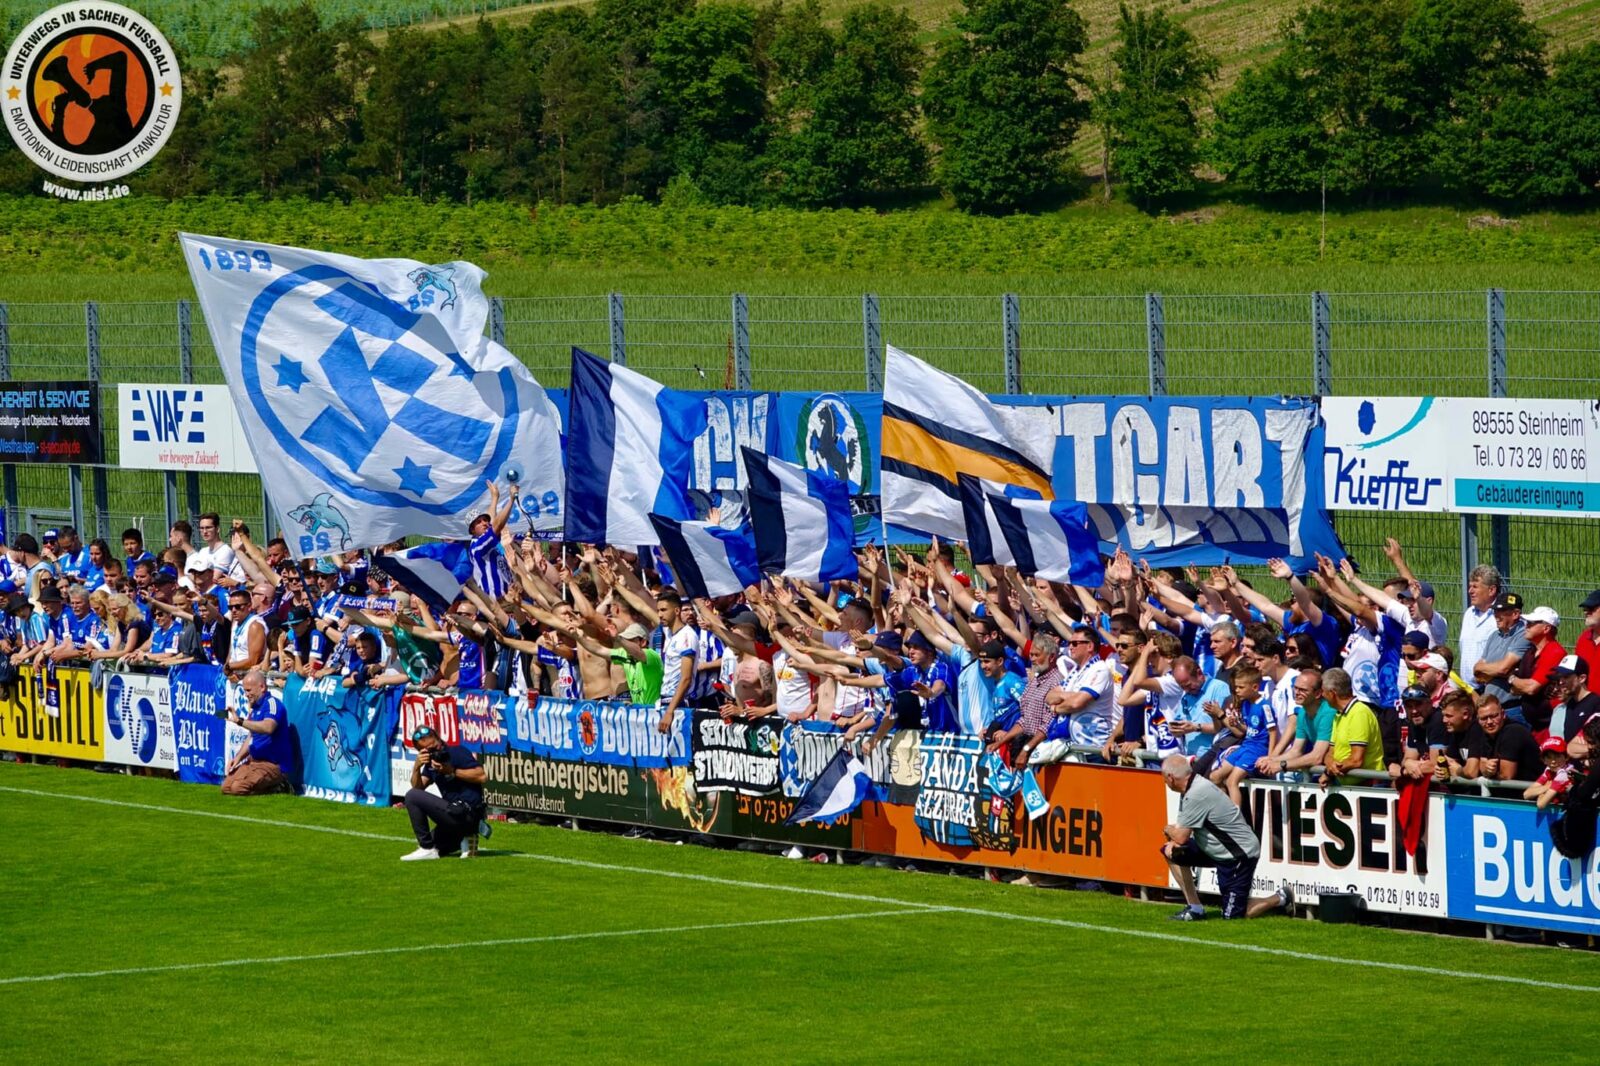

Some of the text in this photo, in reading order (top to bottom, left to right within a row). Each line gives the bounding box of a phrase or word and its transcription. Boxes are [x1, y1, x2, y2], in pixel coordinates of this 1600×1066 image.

[199, 247, 273, 273] 1899
[46, 390, 90, 408] SERVICE
[1472, 411, 1584, 437] 89555 Steinheim
[159, 450, 219, 467] wir bewegen Zukunft
[1472, 445, 1494, 467] Tel.
[1498, 448, 1505, 467] 0
[1508, 448, 1524, 468] 73
[1527, 448, 1542, 468] 29
[1553, 449, 1567, 470] 60
[1571, 449, 1586, 470] 66
[1324, 446, 1442, 510] Kieffer
[1477, 483, 1585, 508] Gebäudereinigung
[300, 532, 332, 555] BS
[158, 688, 169, 703] KV
[173, 681, 216, 716] Blaues
[177, 719, 210, 753] Blut
[514, 699, 574, 749] BLAUE
[159, 748, 174, 761] Steue
[483, 788, 566, 813] Partner von Wüstenrot
[1012, 805, 1103, 858] INGER
[1252, 878, 1275, 892] sheim
[1367, 886, 1372, 901] 0
[1387, 888, 1398, 904] 26
[1405, 890, 1416, 907] 91
[1418, 891, 1429, 908] 92
[1430, 892, 1440, 909] 59
